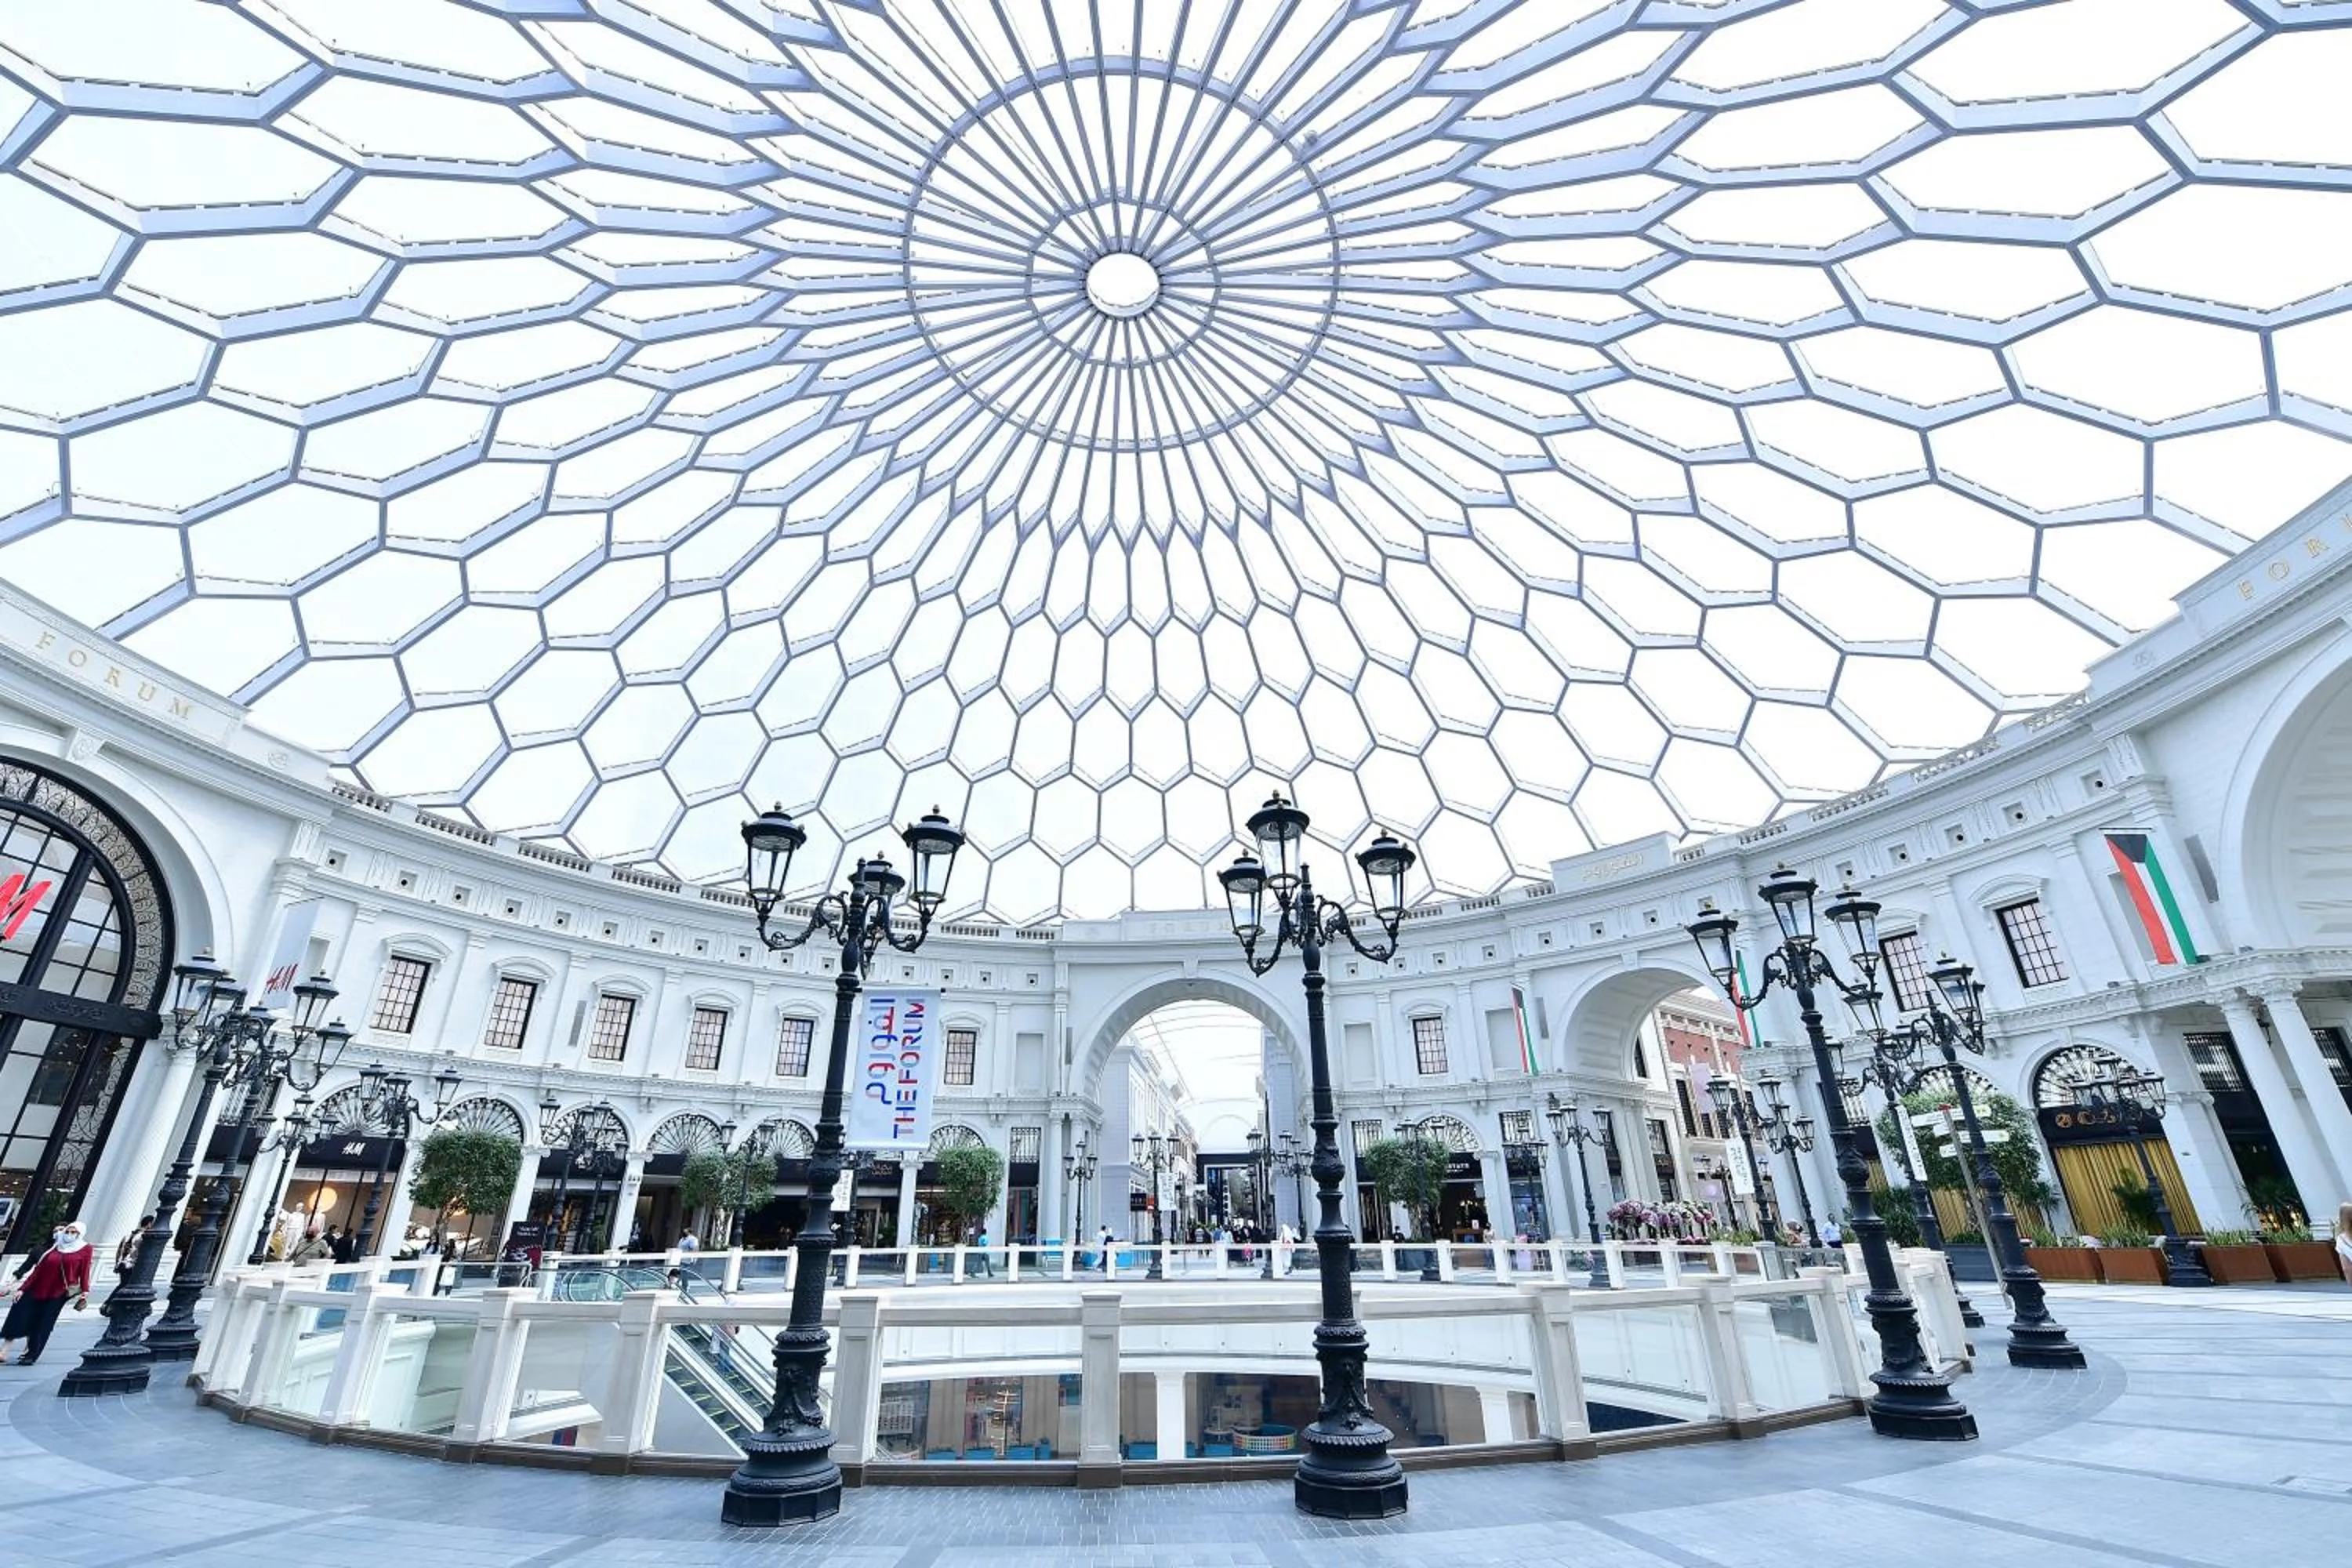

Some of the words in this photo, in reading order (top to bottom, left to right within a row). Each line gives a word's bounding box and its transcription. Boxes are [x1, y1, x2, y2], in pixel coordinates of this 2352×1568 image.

[34, 631, 191, 720] FORUM
[266, 964, 298, 994] H&M
[865, 998, 898, 1105] الفوروم
[898, 998, 926, 1084] FORUM
[892, 1081, 918, 1139] THE
[341, 1141, 367, 1156] H&M
